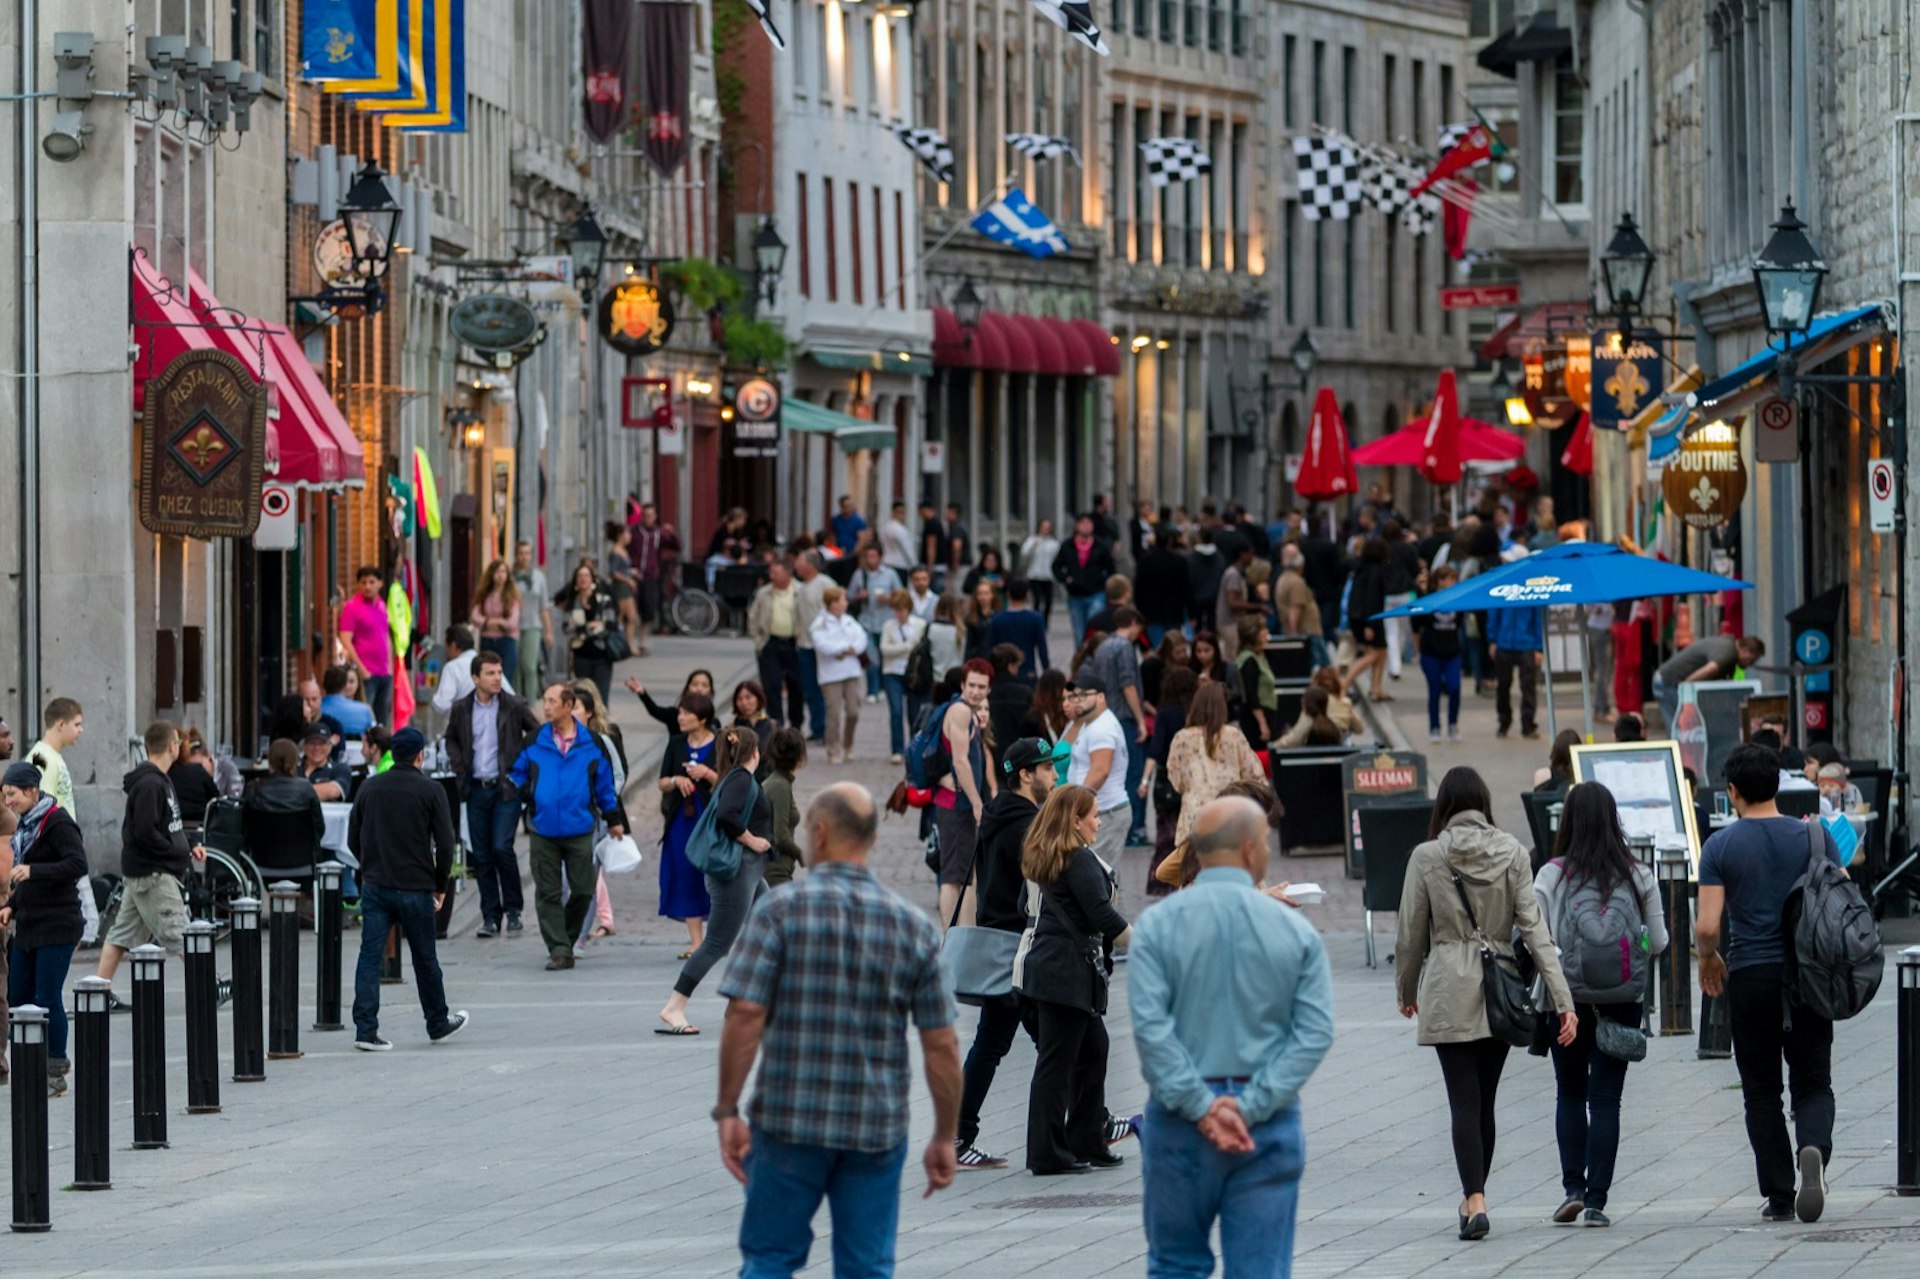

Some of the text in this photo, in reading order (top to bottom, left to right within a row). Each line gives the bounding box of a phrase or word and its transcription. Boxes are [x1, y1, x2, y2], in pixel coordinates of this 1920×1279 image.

[171, 369, 243, 409] RESTAURANT
[158, 494, 244, 516] CHEZ QUEUX
[1489, 583, 1572, 597] Corona
[1805, 636, 1820, 658] P
[1357, 769, 1413, 788] SLEEMAN
